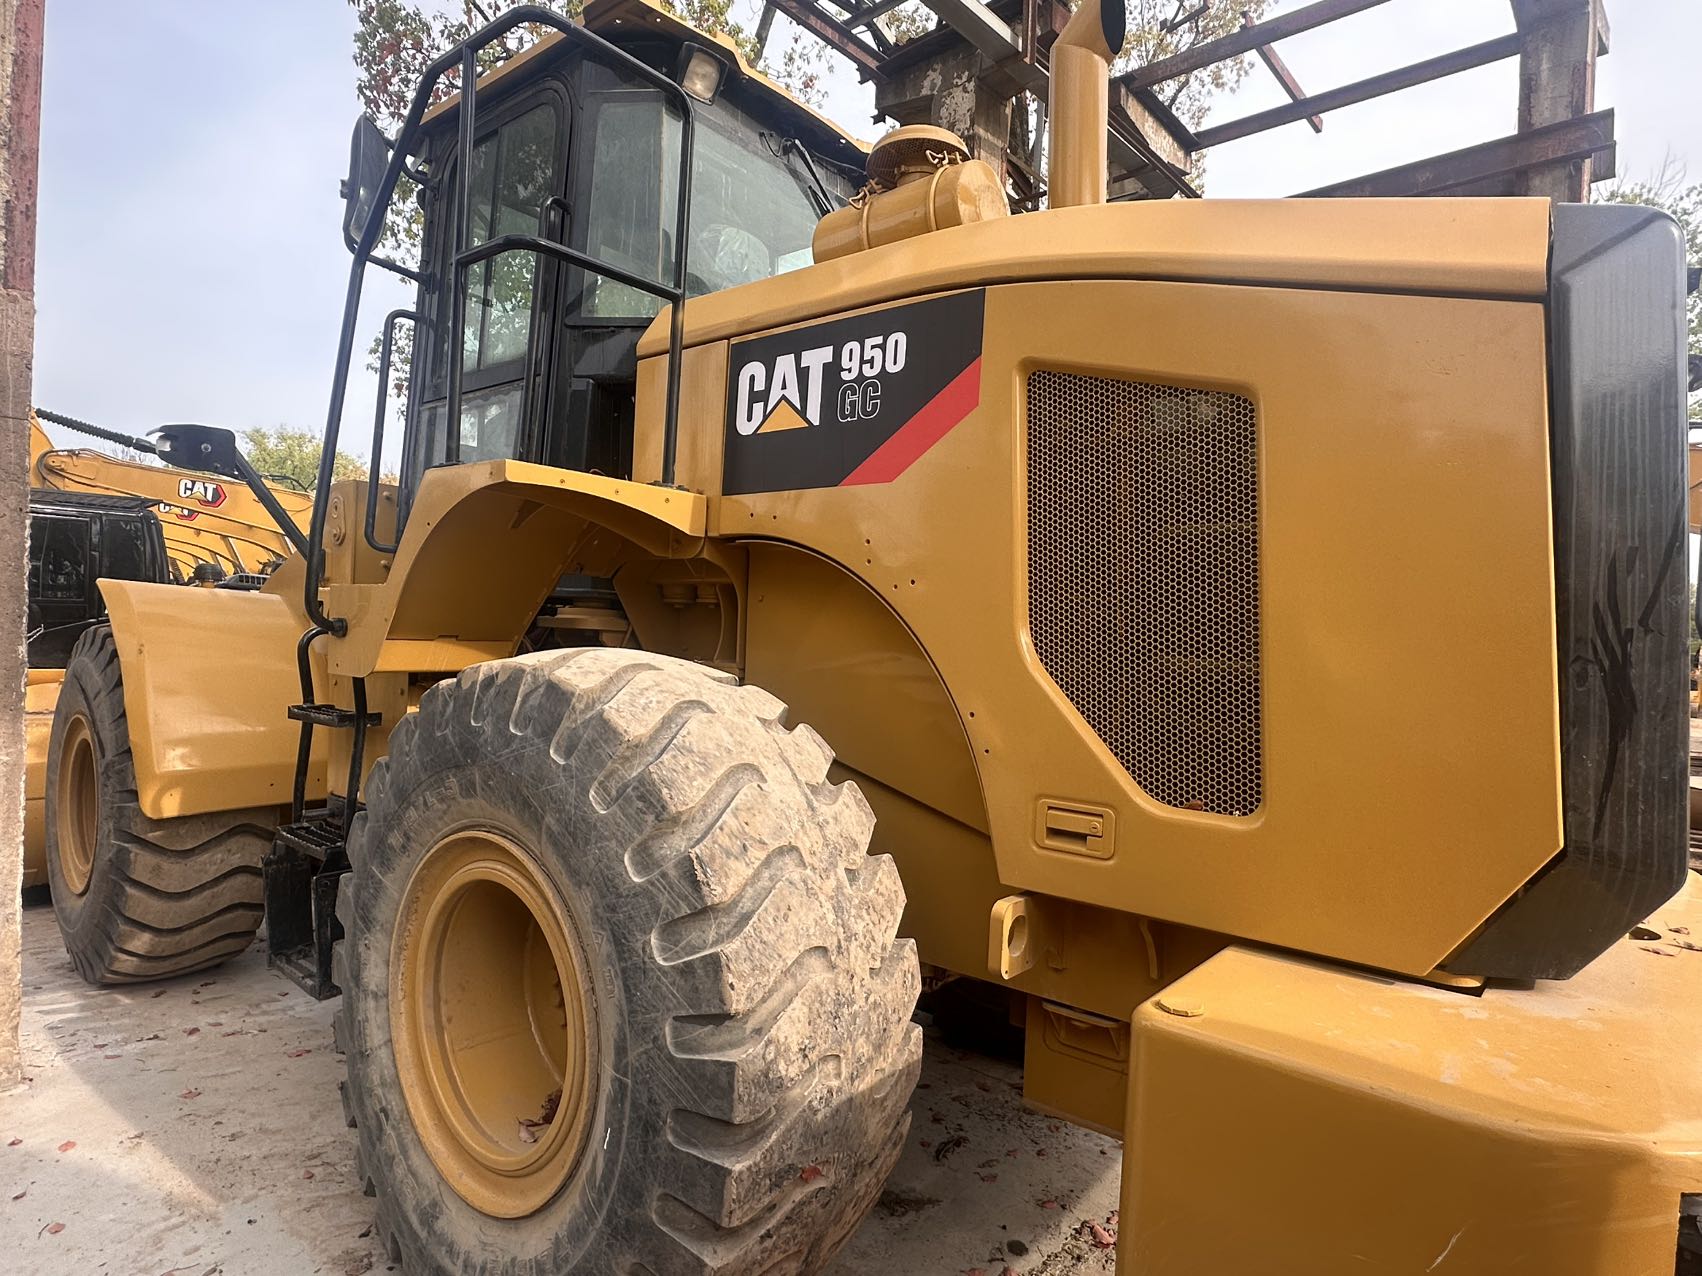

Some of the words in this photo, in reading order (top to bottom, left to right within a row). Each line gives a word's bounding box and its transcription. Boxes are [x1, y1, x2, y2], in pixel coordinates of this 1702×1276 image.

[736, 346, 833, 436] CAT
[840, 331, 907, 381] 950
[837, 379, 881, 422] GC
[179, 479, 217, 502] CAT
